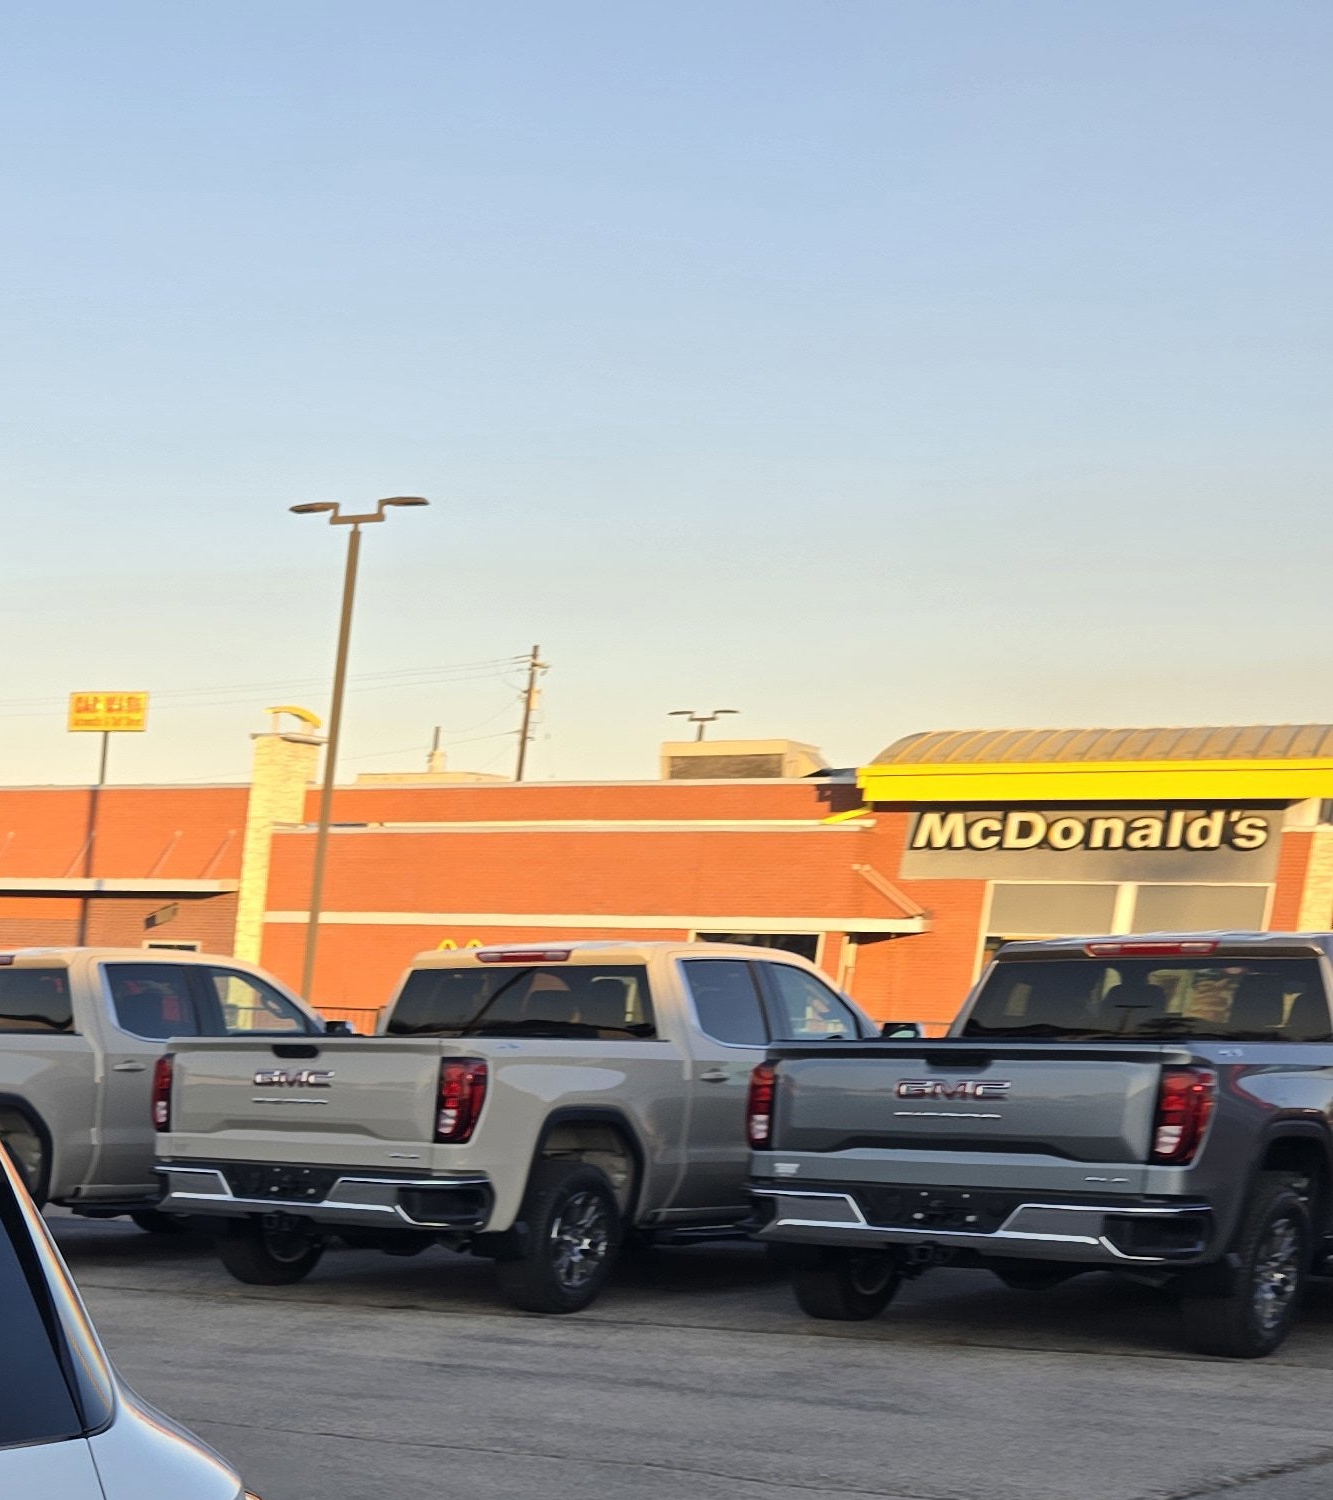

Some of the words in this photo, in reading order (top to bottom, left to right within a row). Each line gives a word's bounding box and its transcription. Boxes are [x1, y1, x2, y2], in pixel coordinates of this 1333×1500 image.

[911, 810, 1268, 849] McDonald's
[253, 1070, 335, 1087] GMC
[895, 1079, 1012, 1100] GMC
